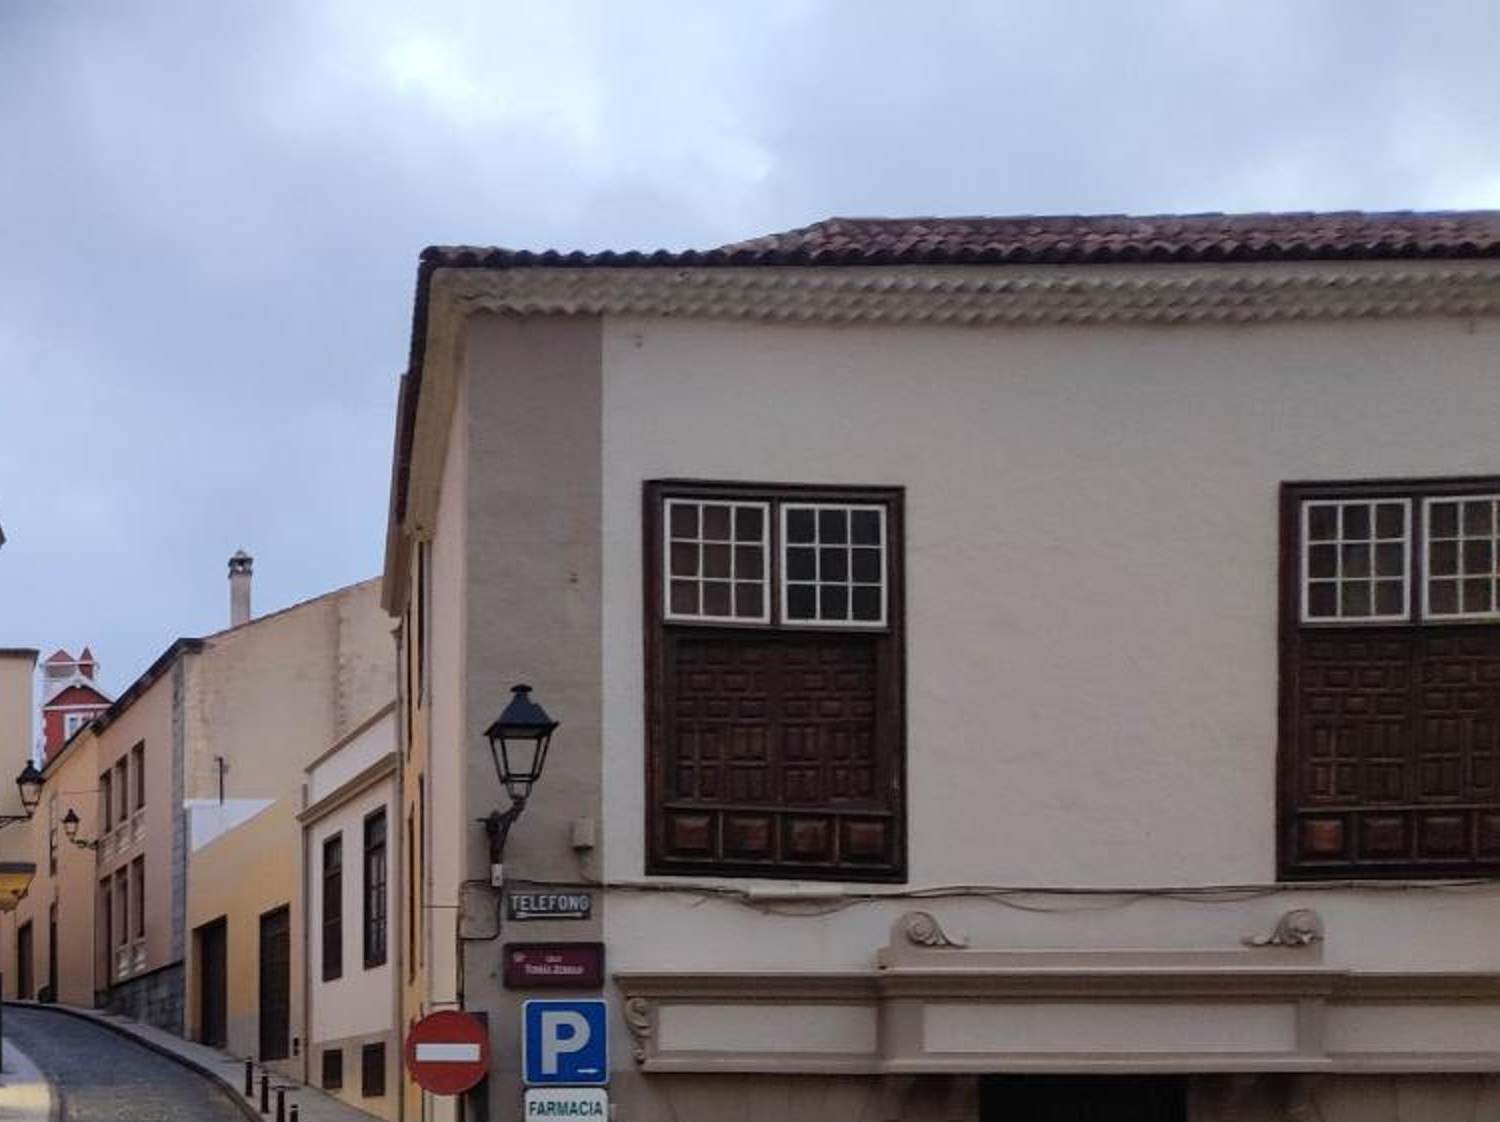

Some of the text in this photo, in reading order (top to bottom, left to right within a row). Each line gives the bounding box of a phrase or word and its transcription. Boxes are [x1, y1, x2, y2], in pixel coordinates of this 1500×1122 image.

[510, 895, 590, 911] TELEFONO
[541, 1011, 591, 1075] P
[528, 1101, 603, 1116] FARMACIA
